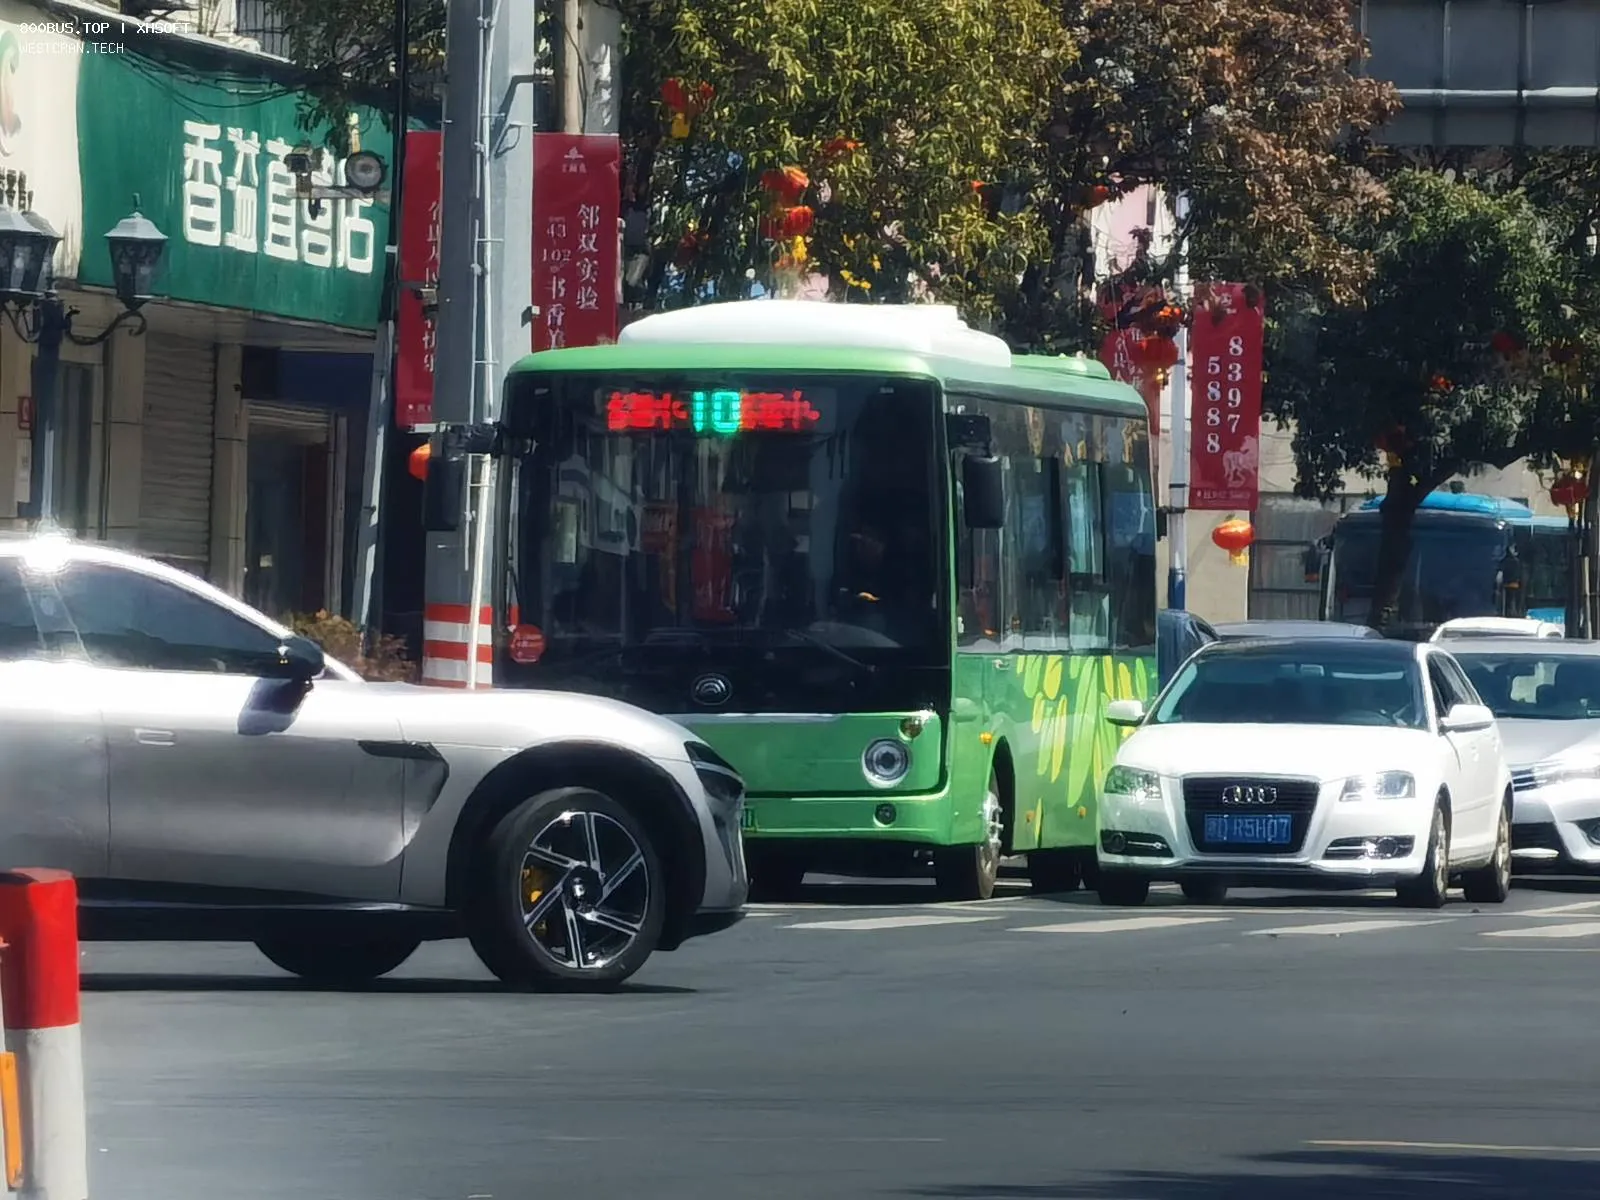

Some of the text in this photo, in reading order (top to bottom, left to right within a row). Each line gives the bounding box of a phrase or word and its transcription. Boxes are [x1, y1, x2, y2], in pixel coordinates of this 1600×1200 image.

[693, 390, 741, 433] 10
[1206, 355, 1222, 455] 5888
[1227, 336, 1243, 434] 8397
